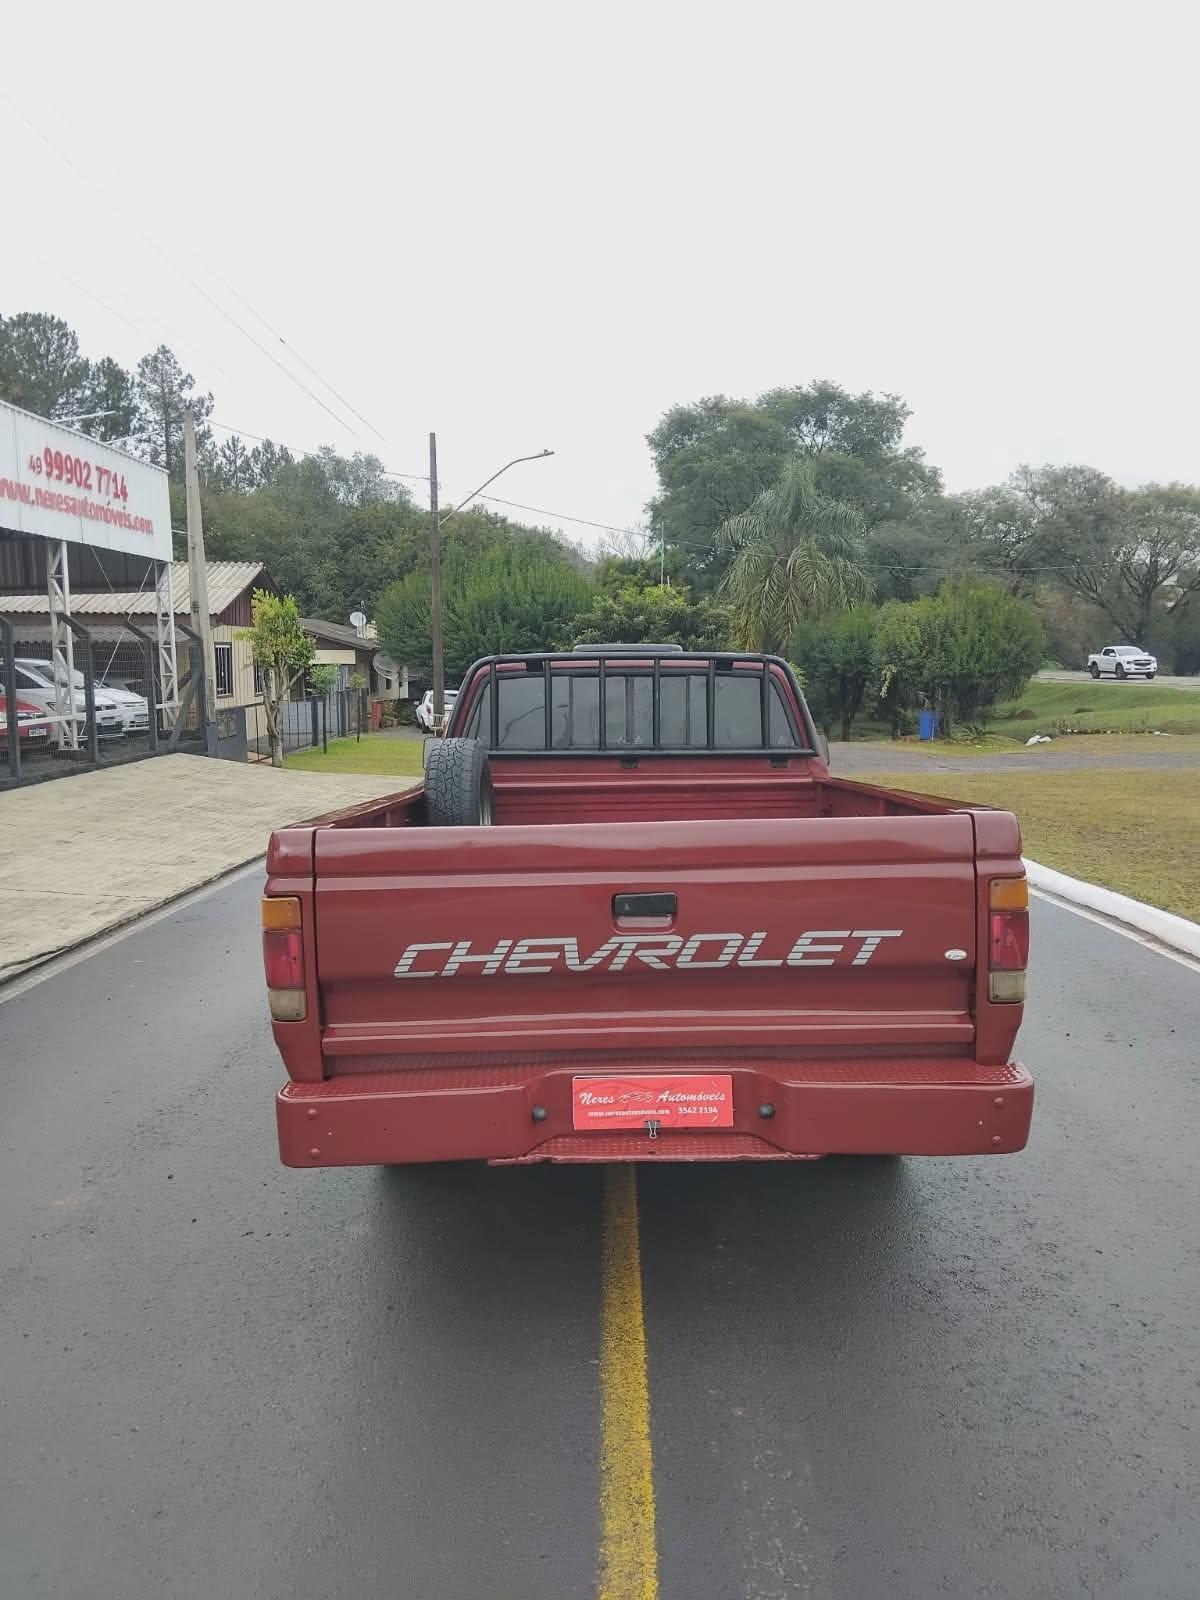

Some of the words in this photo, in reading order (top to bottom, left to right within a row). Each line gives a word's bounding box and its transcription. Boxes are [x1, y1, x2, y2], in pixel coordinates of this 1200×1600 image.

[29, 454, 42, 475] 49
[44, 447, 92, 490] 99902
[95, 465, 128, 502] 7714
[393, 929, 904, 978] CHEVROLET
[578, 1092, 615, 1105] Neres
[656, 1090, 726, 1103] Automóveis
